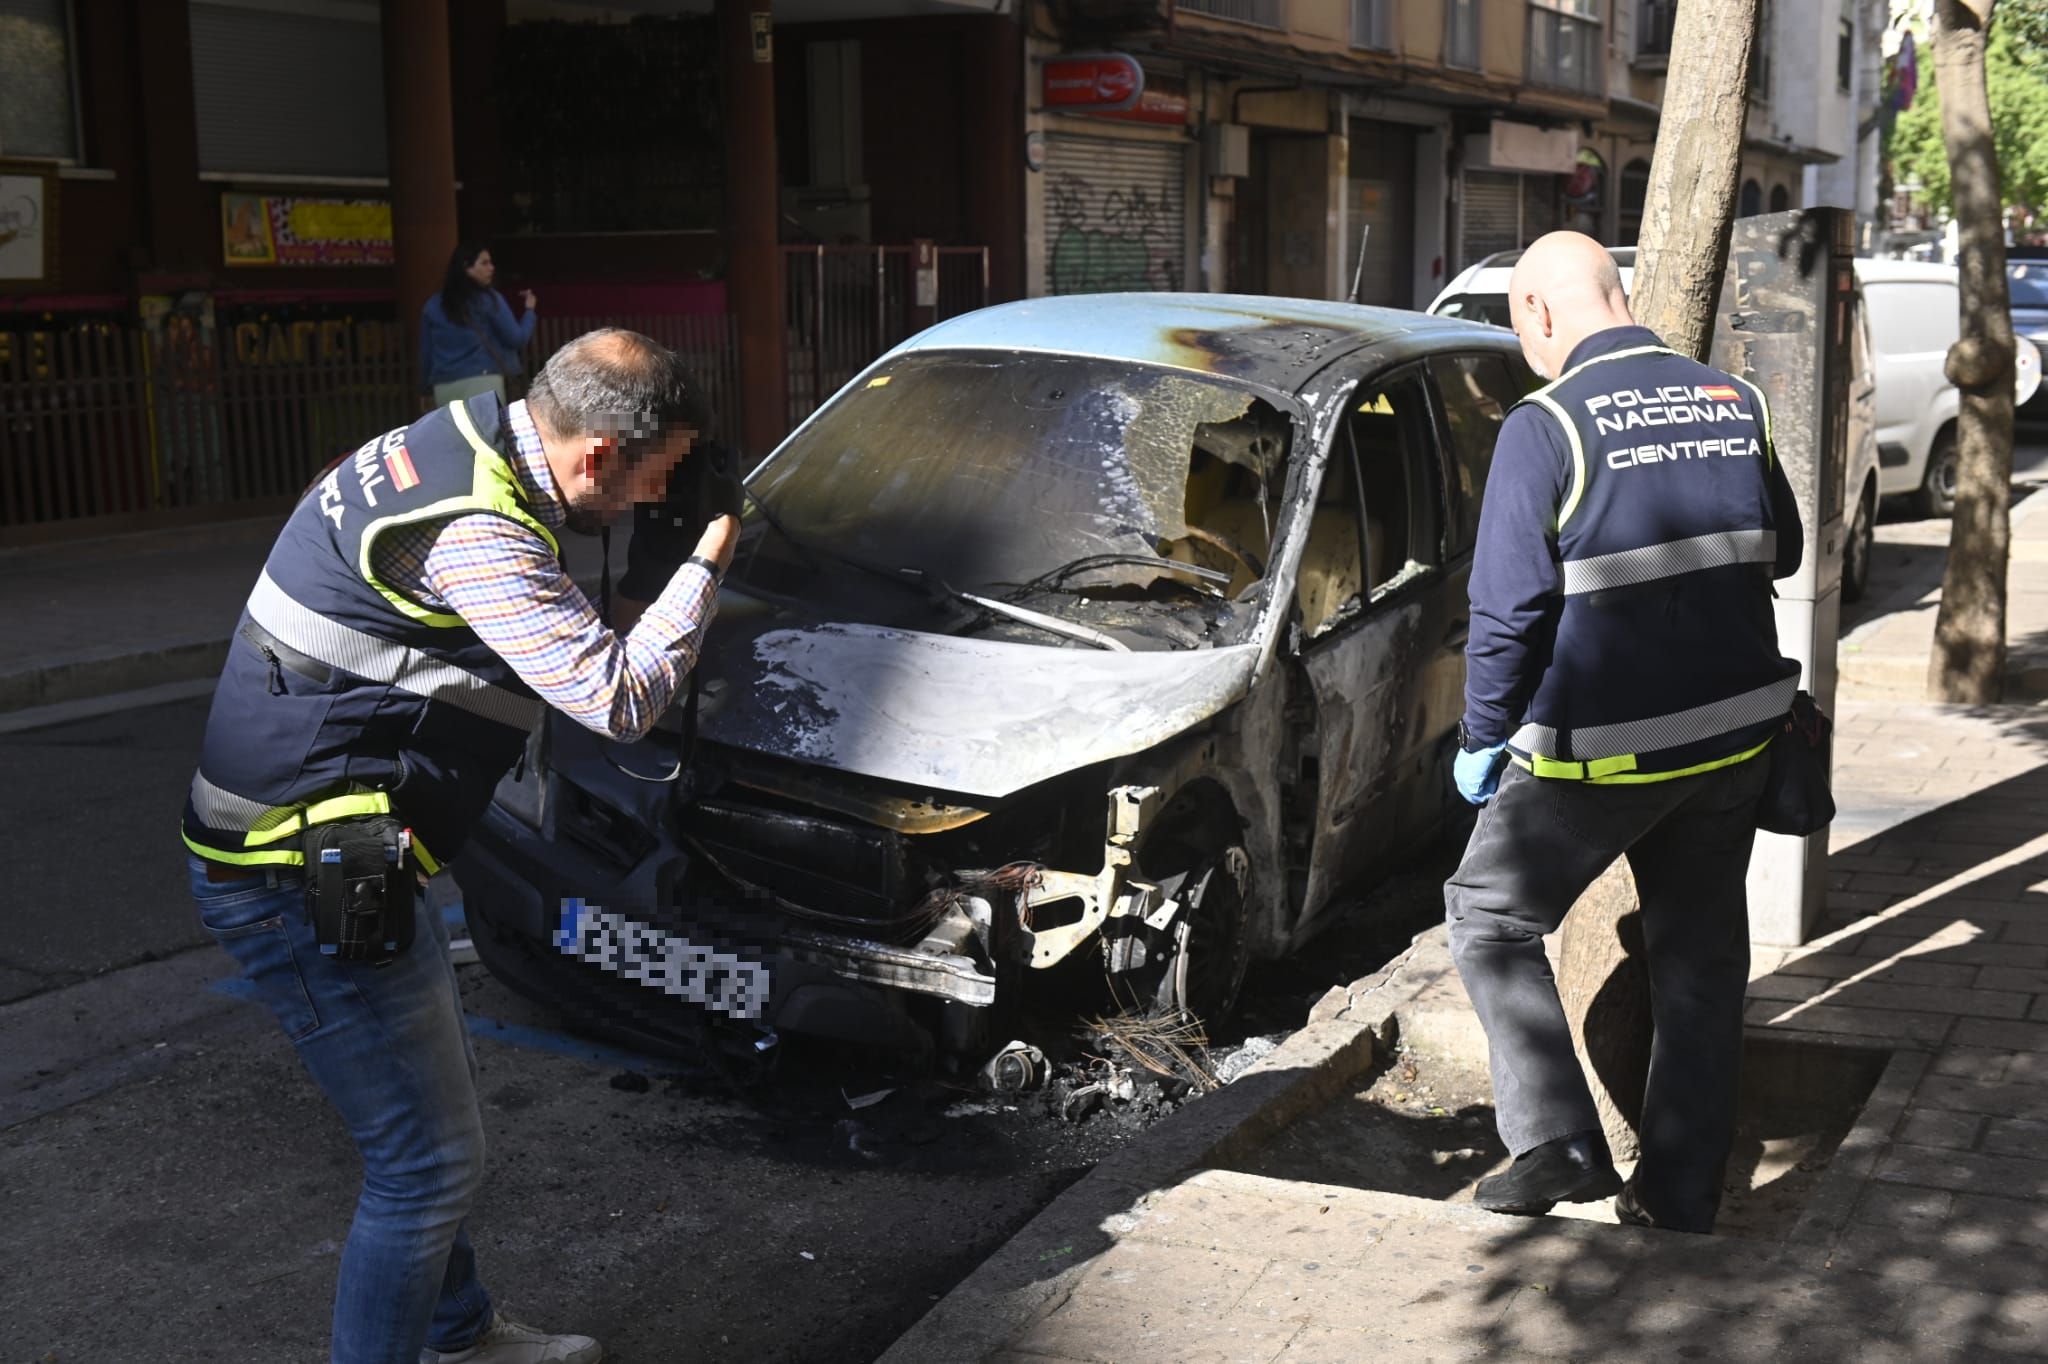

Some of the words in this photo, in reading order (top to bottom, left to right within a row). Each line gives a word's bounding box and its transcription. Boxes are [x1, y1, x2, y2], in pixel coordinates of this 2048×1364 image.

[1585, 386, 1712, 415] POLICIA
[1595, 403, 1753, 436] NACIONAL
[1607, 438, 1761, 470] CIENTIFICA
